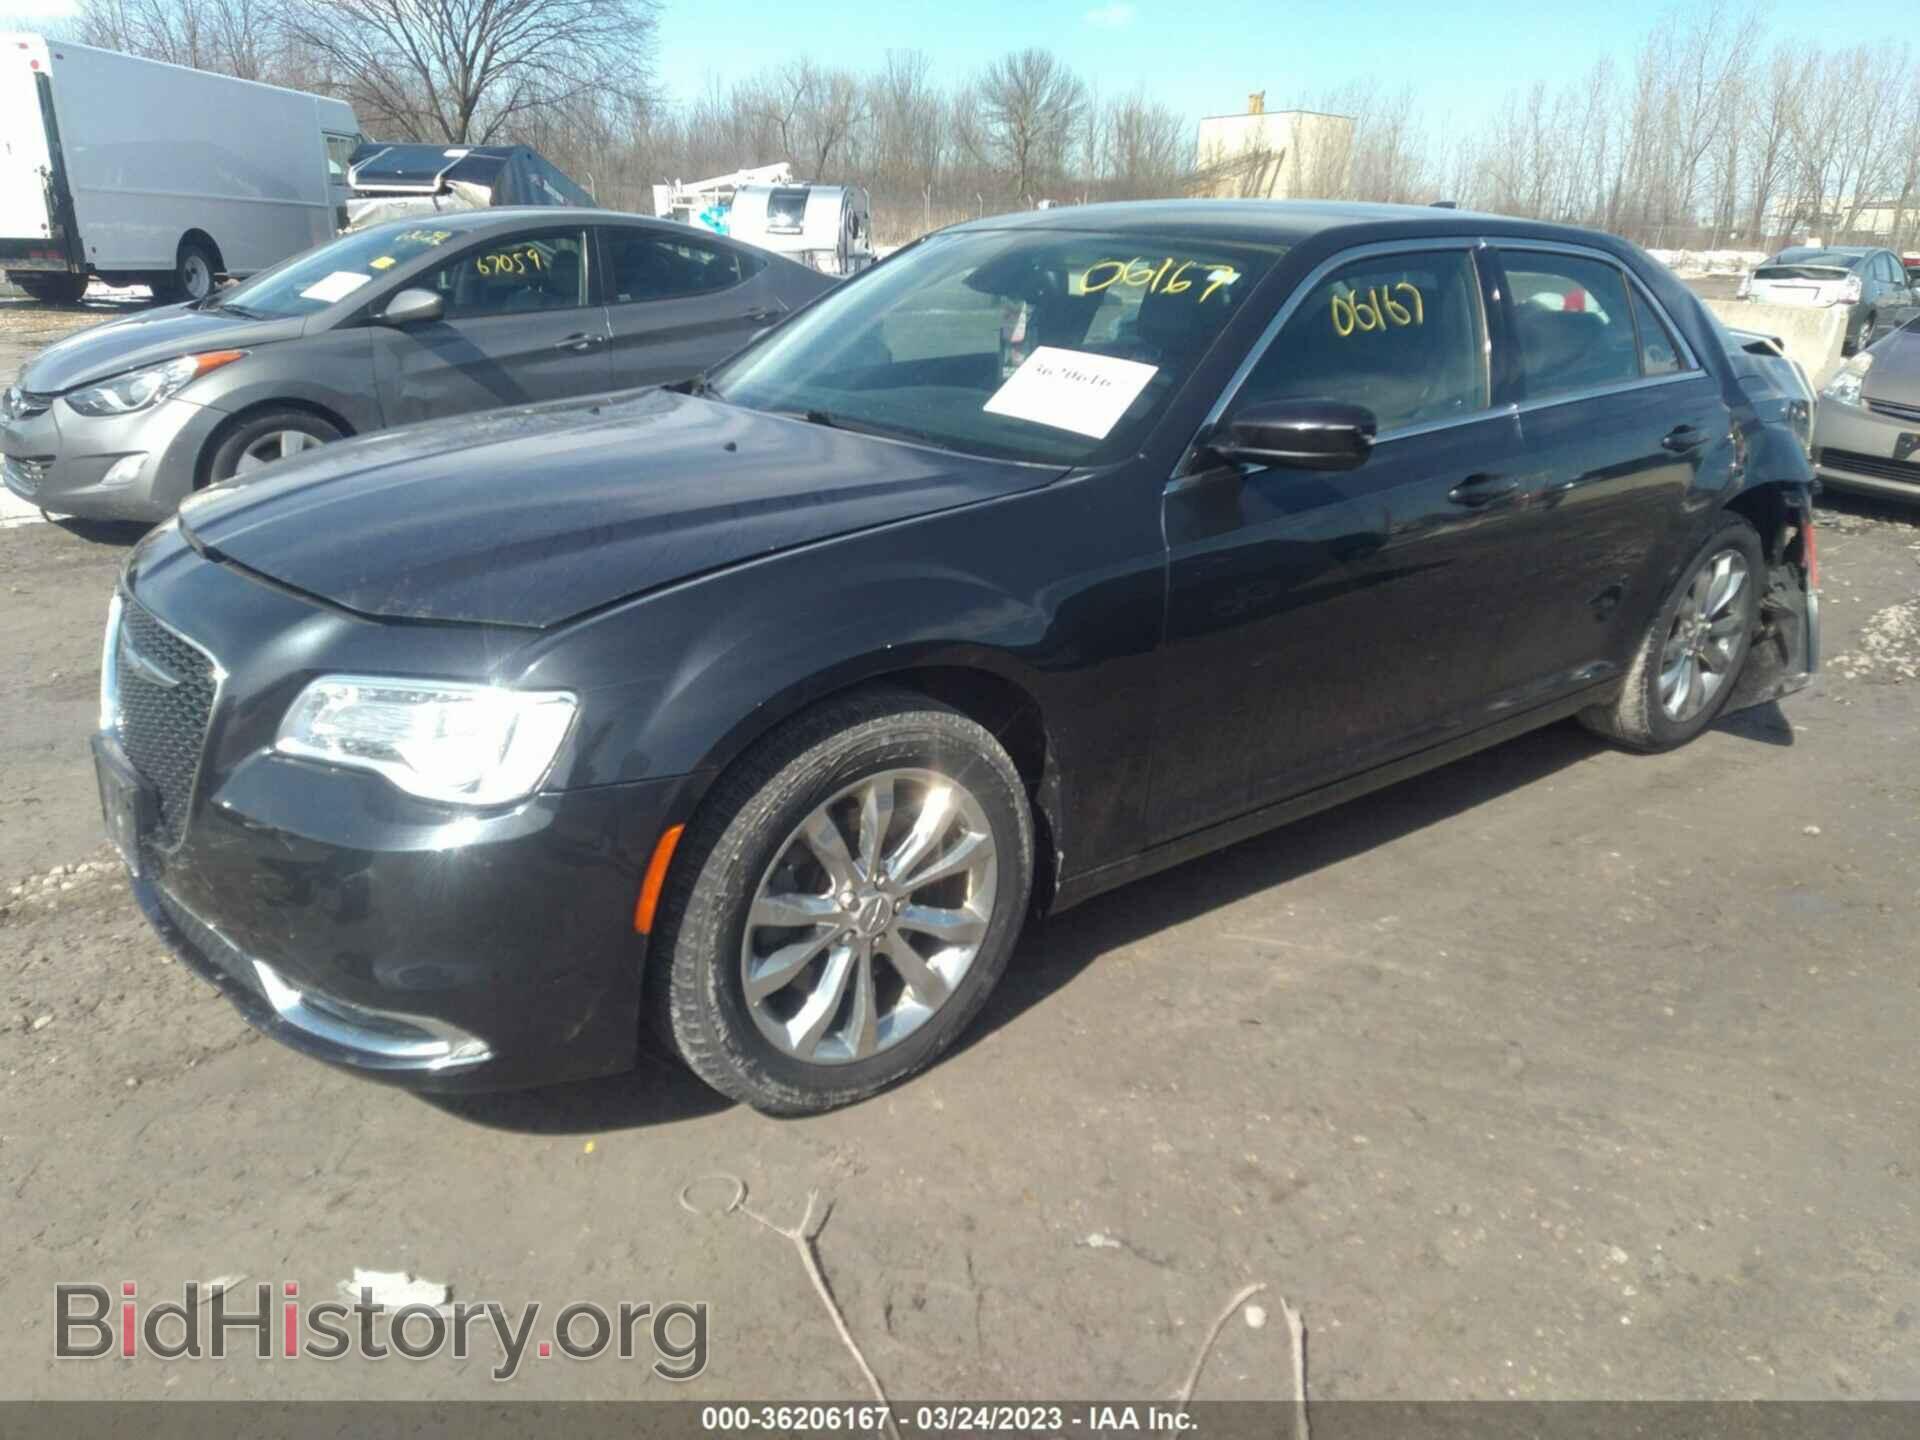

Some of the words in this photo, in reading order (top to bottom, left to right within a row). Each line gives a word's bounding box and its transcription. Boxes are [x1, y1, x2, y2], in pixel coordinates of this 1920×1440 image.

[477, 249, 541, 275] 67059
[1080, 256, 1234, 303] 06167
[1332, 282, 1424, 336] 06167
